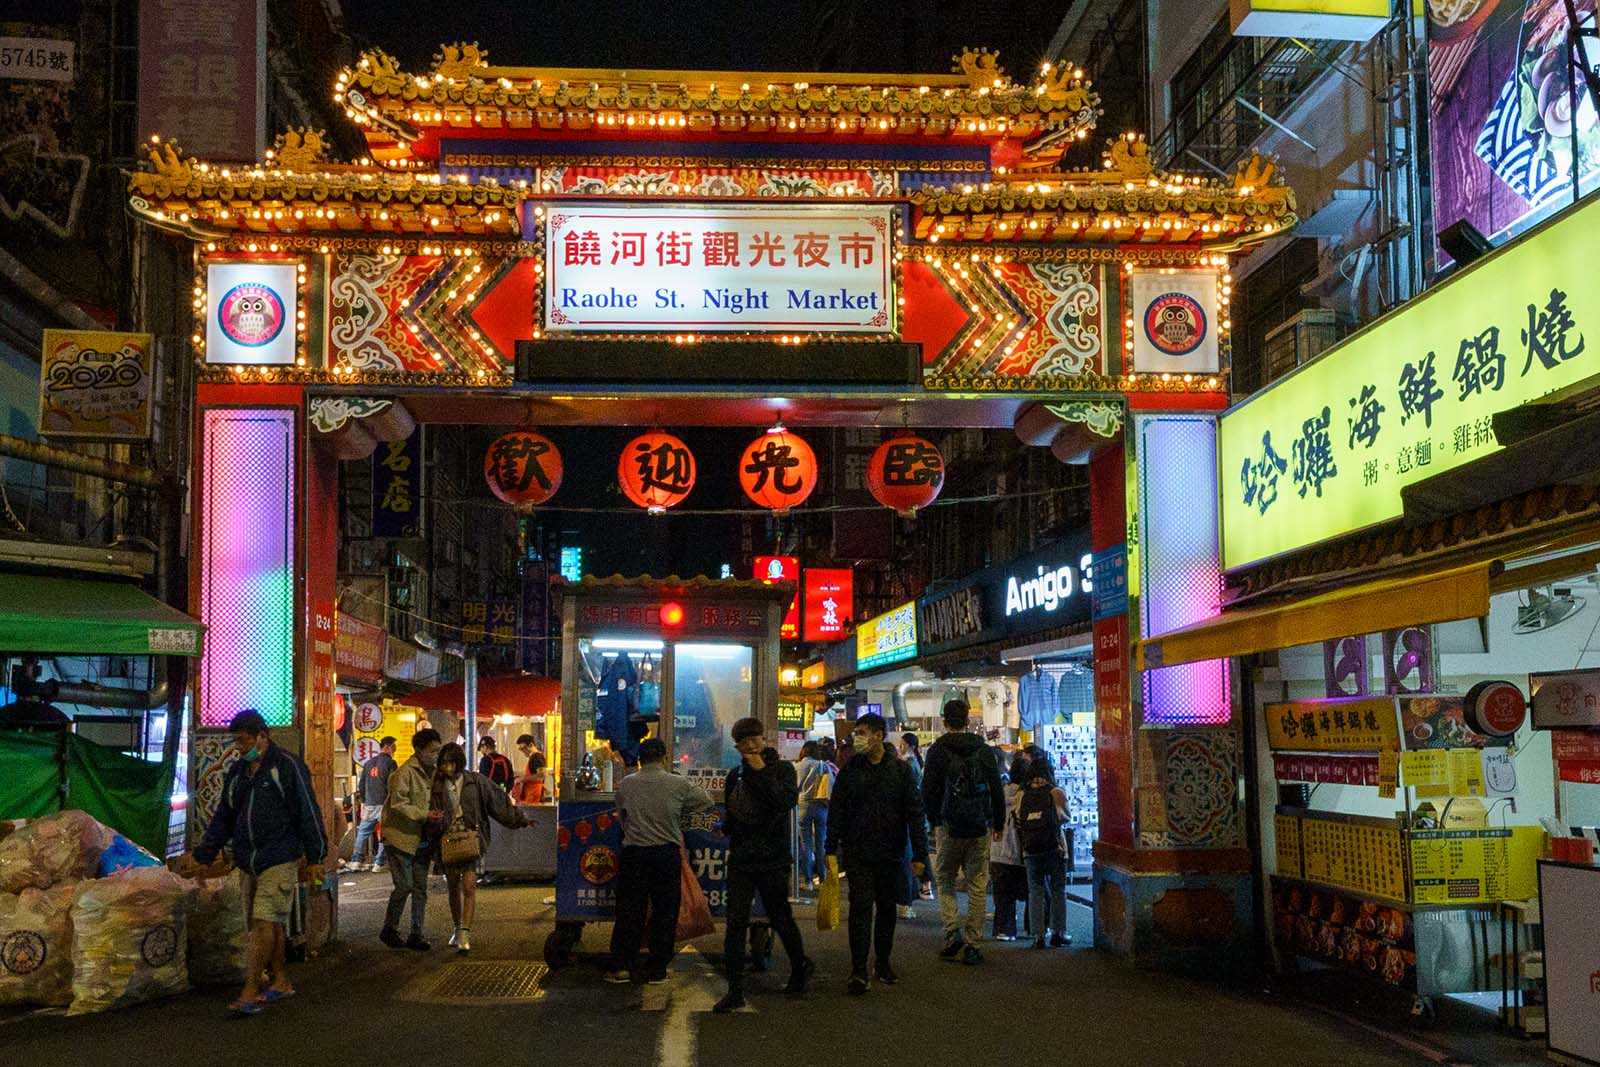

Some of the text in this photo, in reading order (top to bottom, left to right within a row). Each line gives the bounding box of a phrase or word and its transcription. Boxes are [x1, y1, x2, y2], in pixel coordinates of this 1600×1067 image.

[563, 230, 875, 268] 饒河街觀光夜市
[562, 288, 878, 314] Raohe St. Night Market
[48, 364, 142, 391] 2020
[489, 437, 942, 494] 歡 迎 光 臨
[1005, 564, 1073, 616] Amigo
[315, 613, 331, 630] 12-24
[1100, 634, 1118, 649] 12-24
